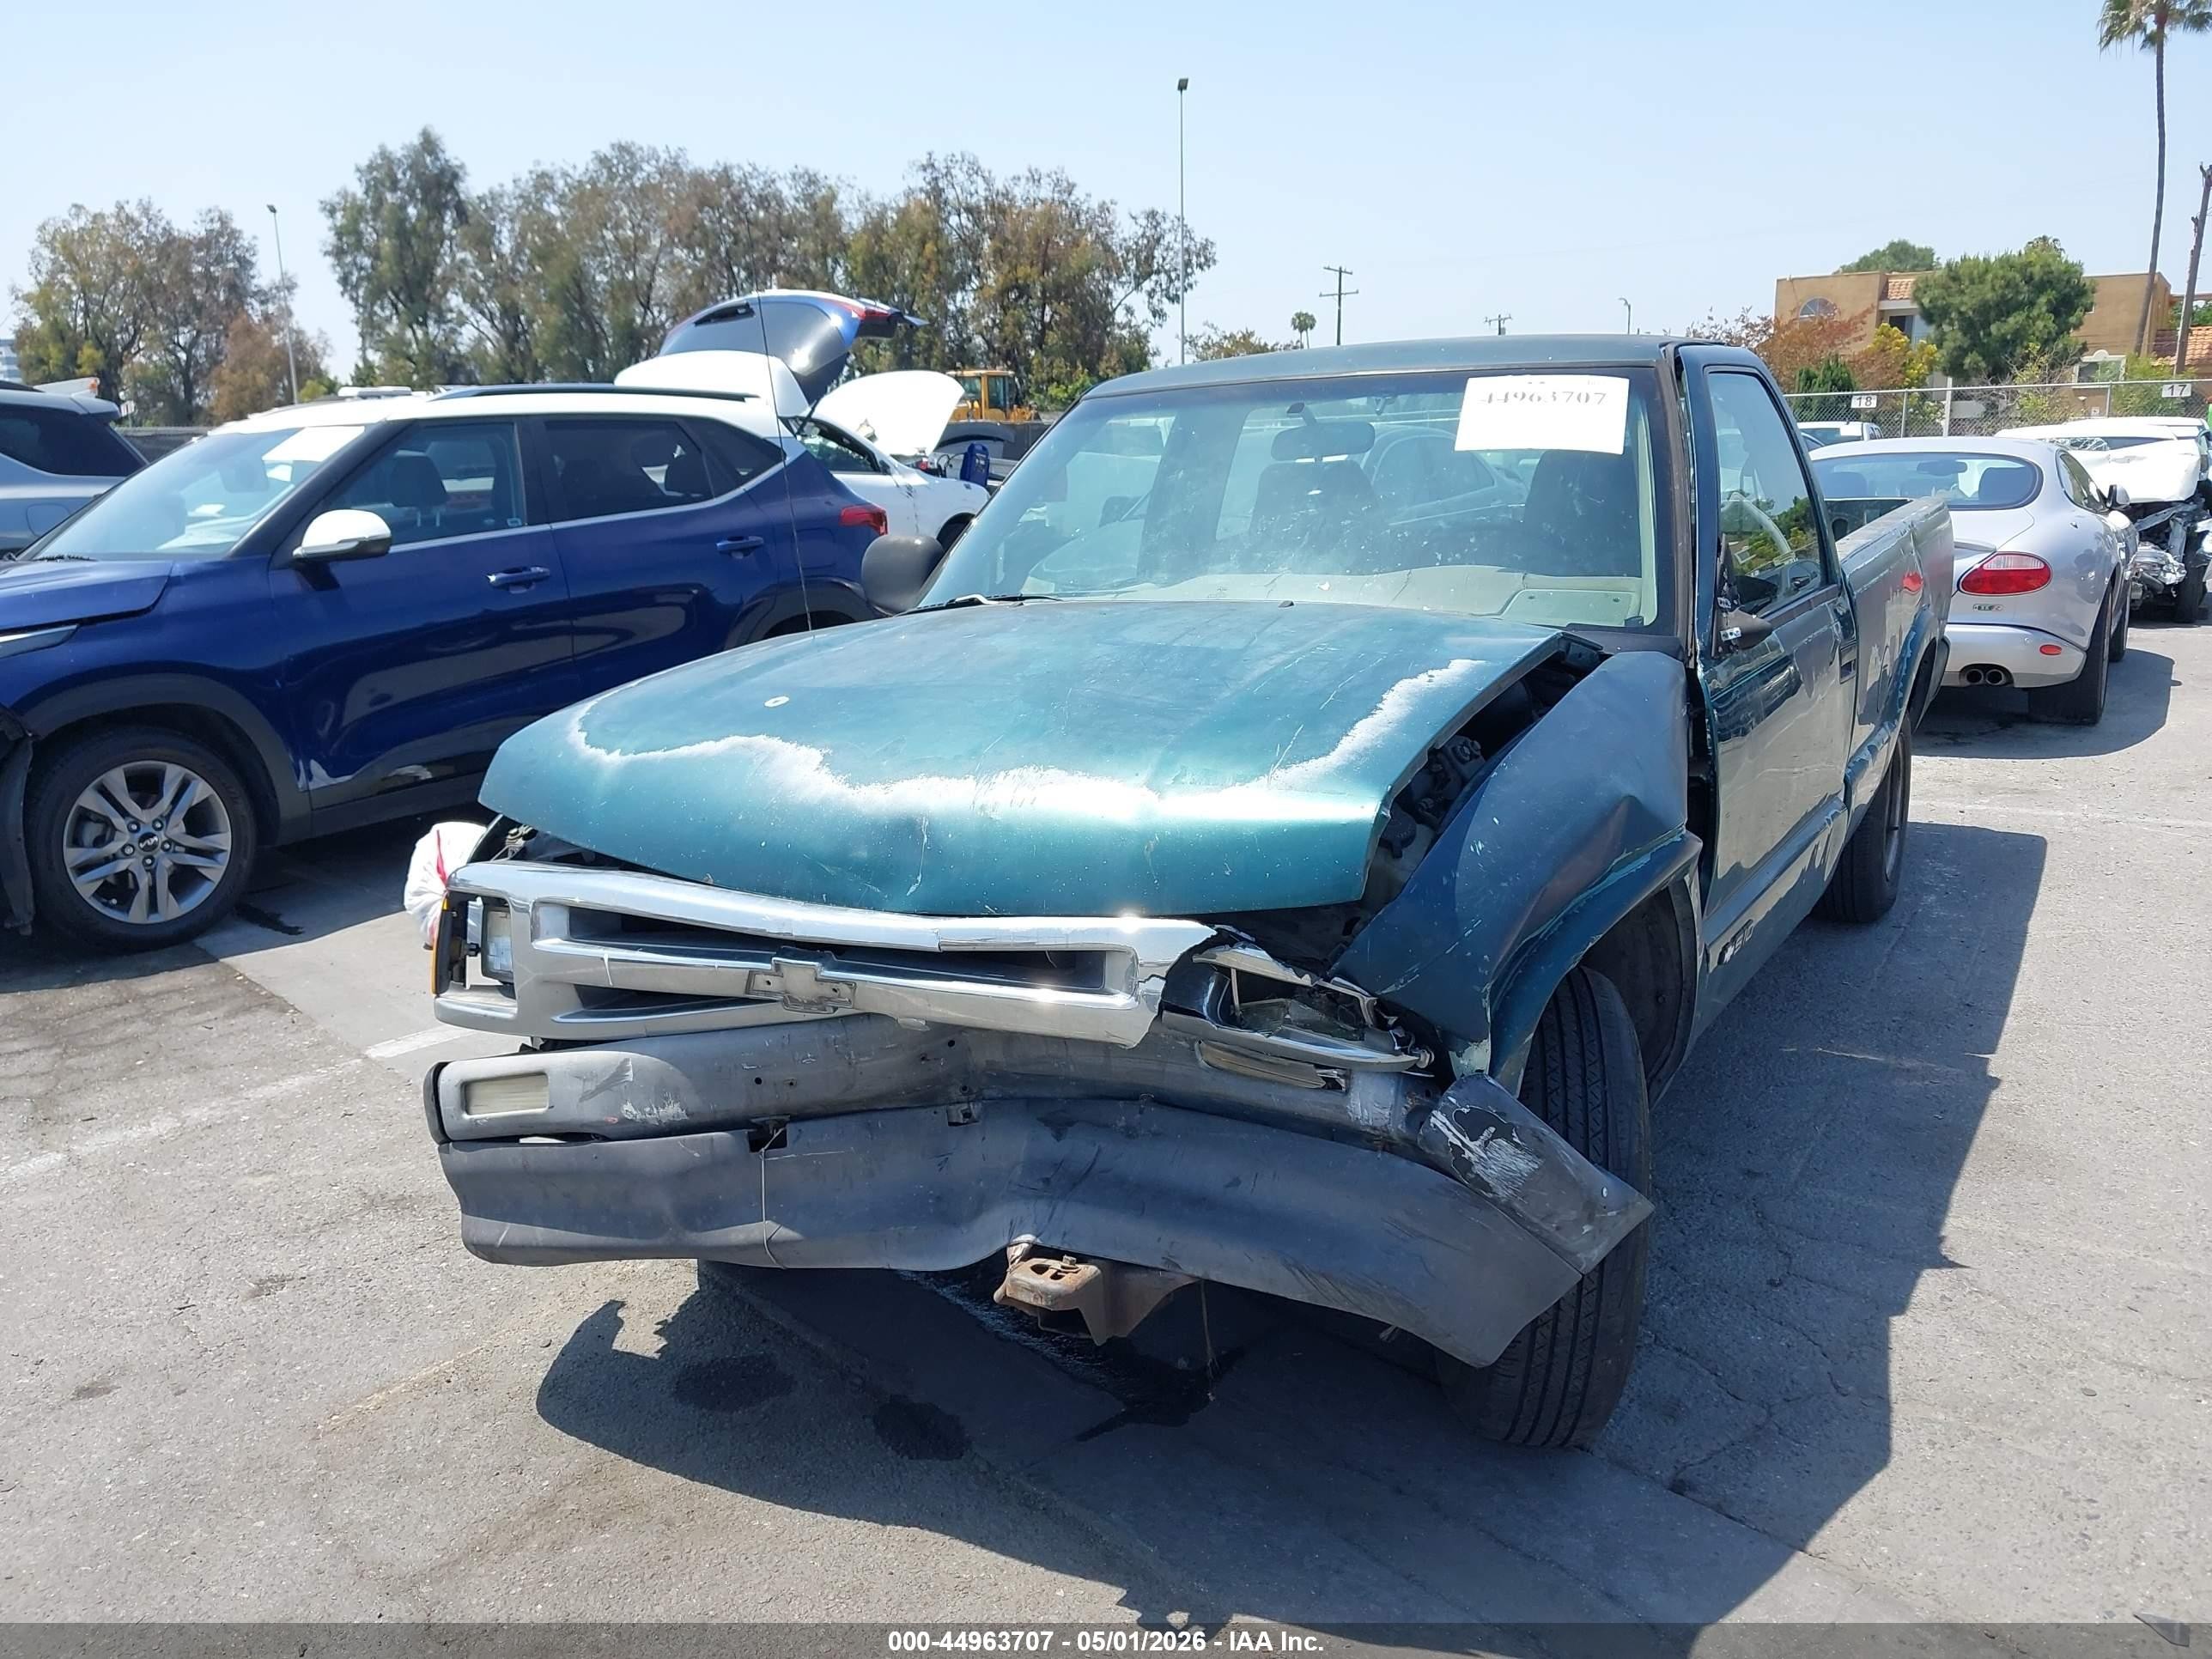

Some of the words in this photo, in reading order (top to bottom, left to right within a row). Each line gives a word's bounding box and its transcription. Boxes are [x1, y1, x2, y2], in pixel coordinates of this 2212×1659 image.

[2167, 384, 2187, 396] 17
[1478, 391, 1608, 405] 44963707
[1856, 396, 1872, 407] 18
